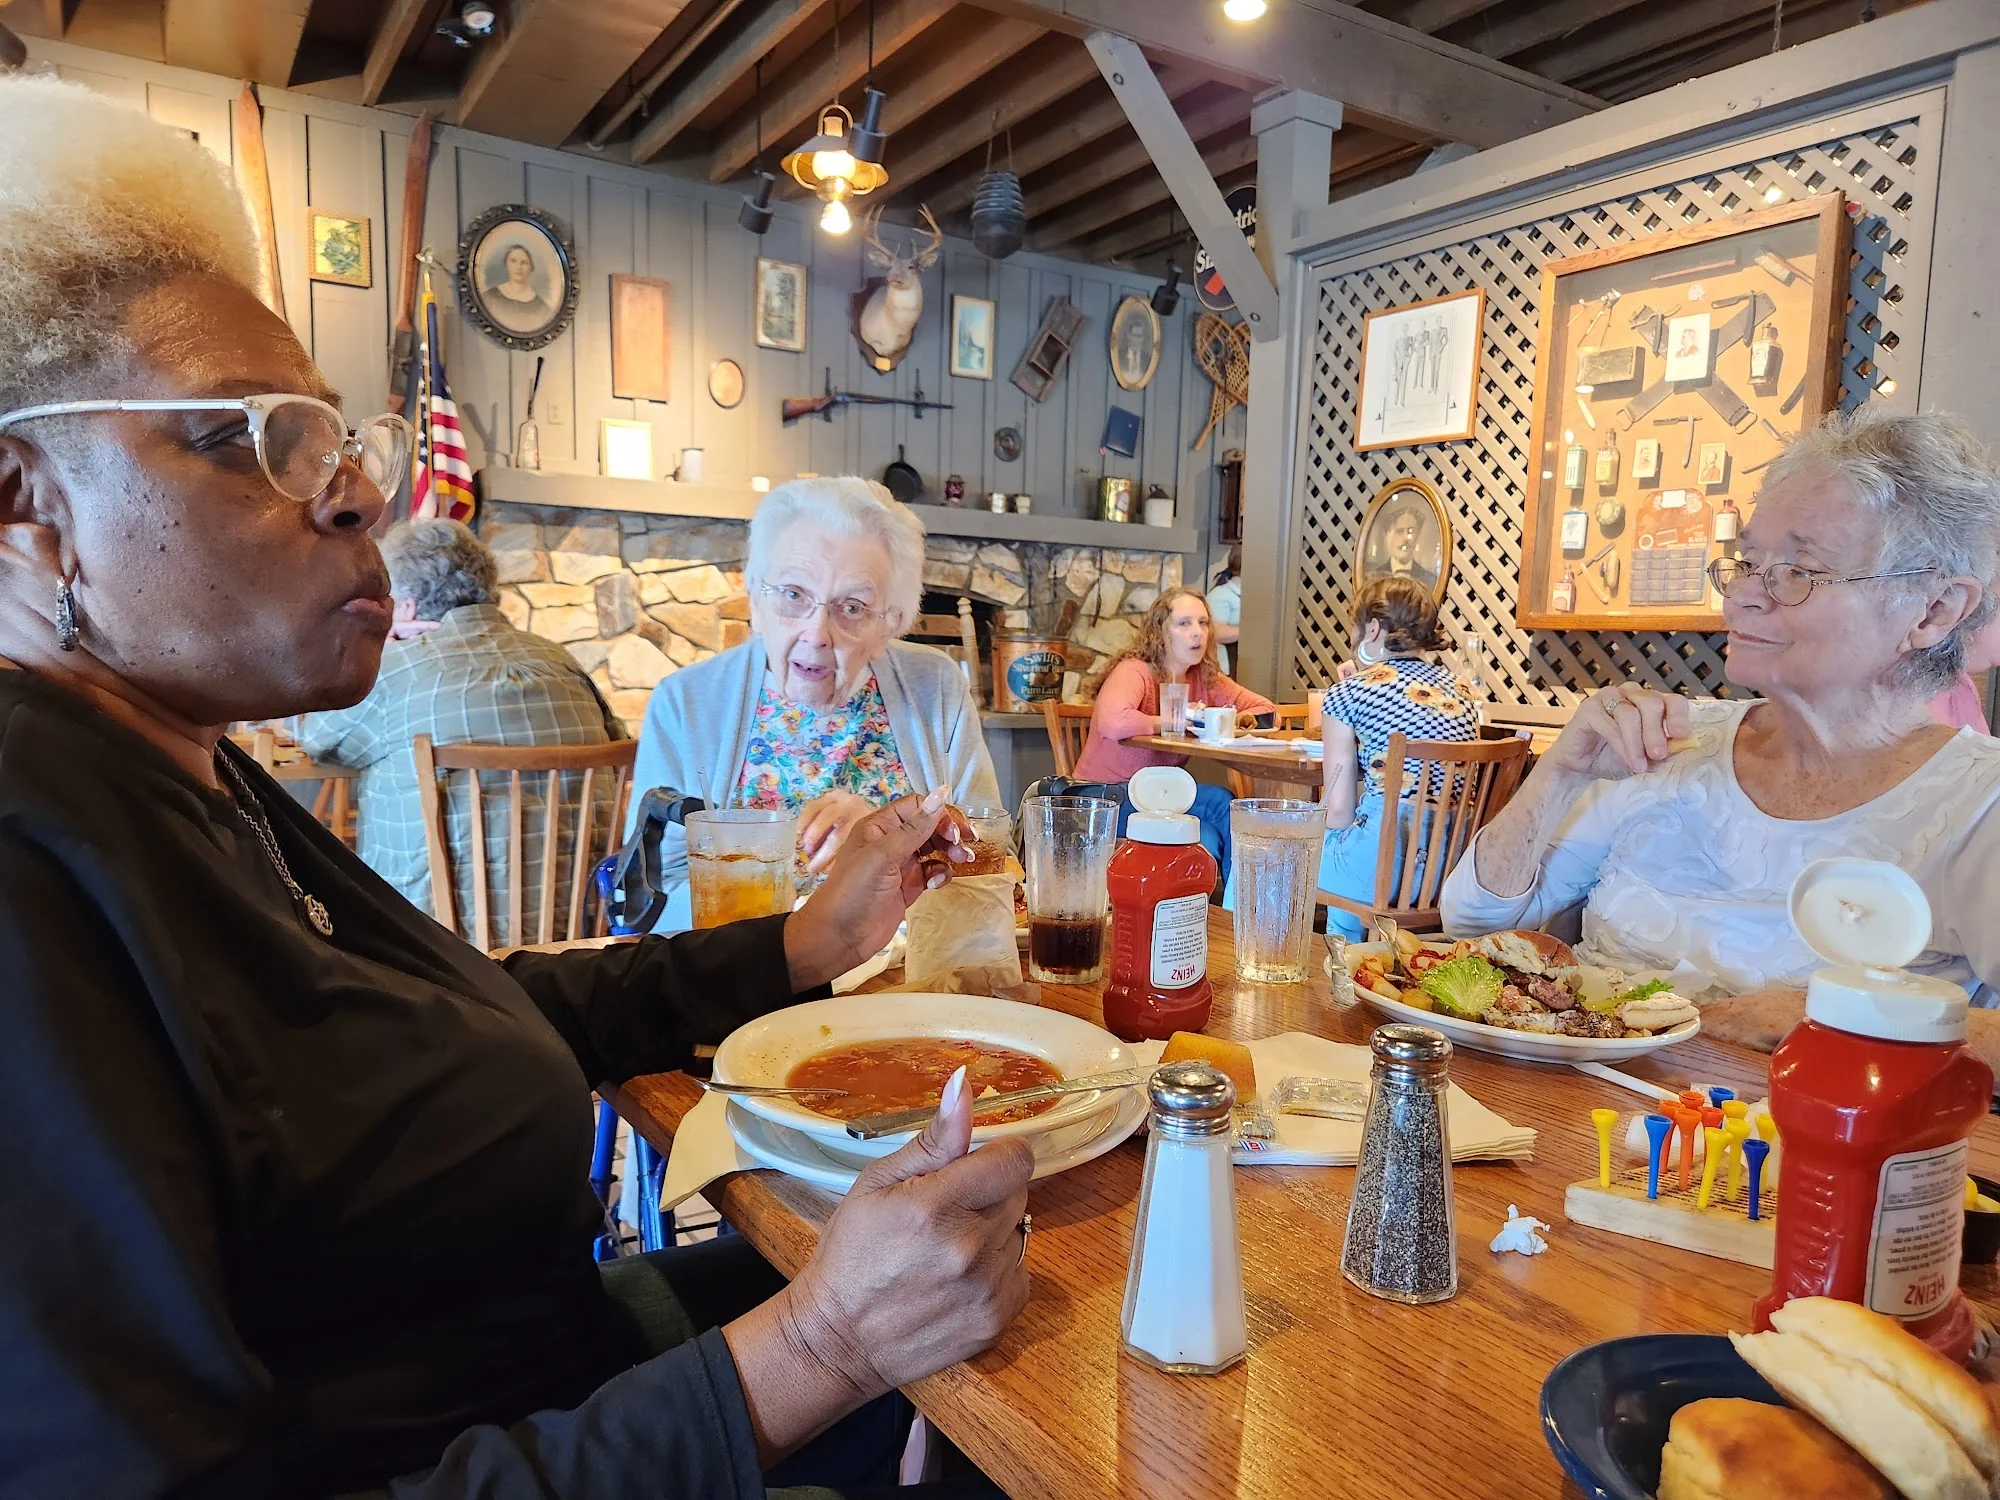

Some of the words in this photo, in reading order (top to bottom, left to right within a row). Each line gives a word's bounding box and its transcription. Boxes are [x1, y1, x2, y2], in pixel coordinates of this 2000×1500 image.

[1024, 653, 1059, 664] Swift's
[1021, 686, 1040, 694] Pure
[1171, 965, 1196, 981] HEINZ
[1903, 1276, 1945, 1305] HEINZ
